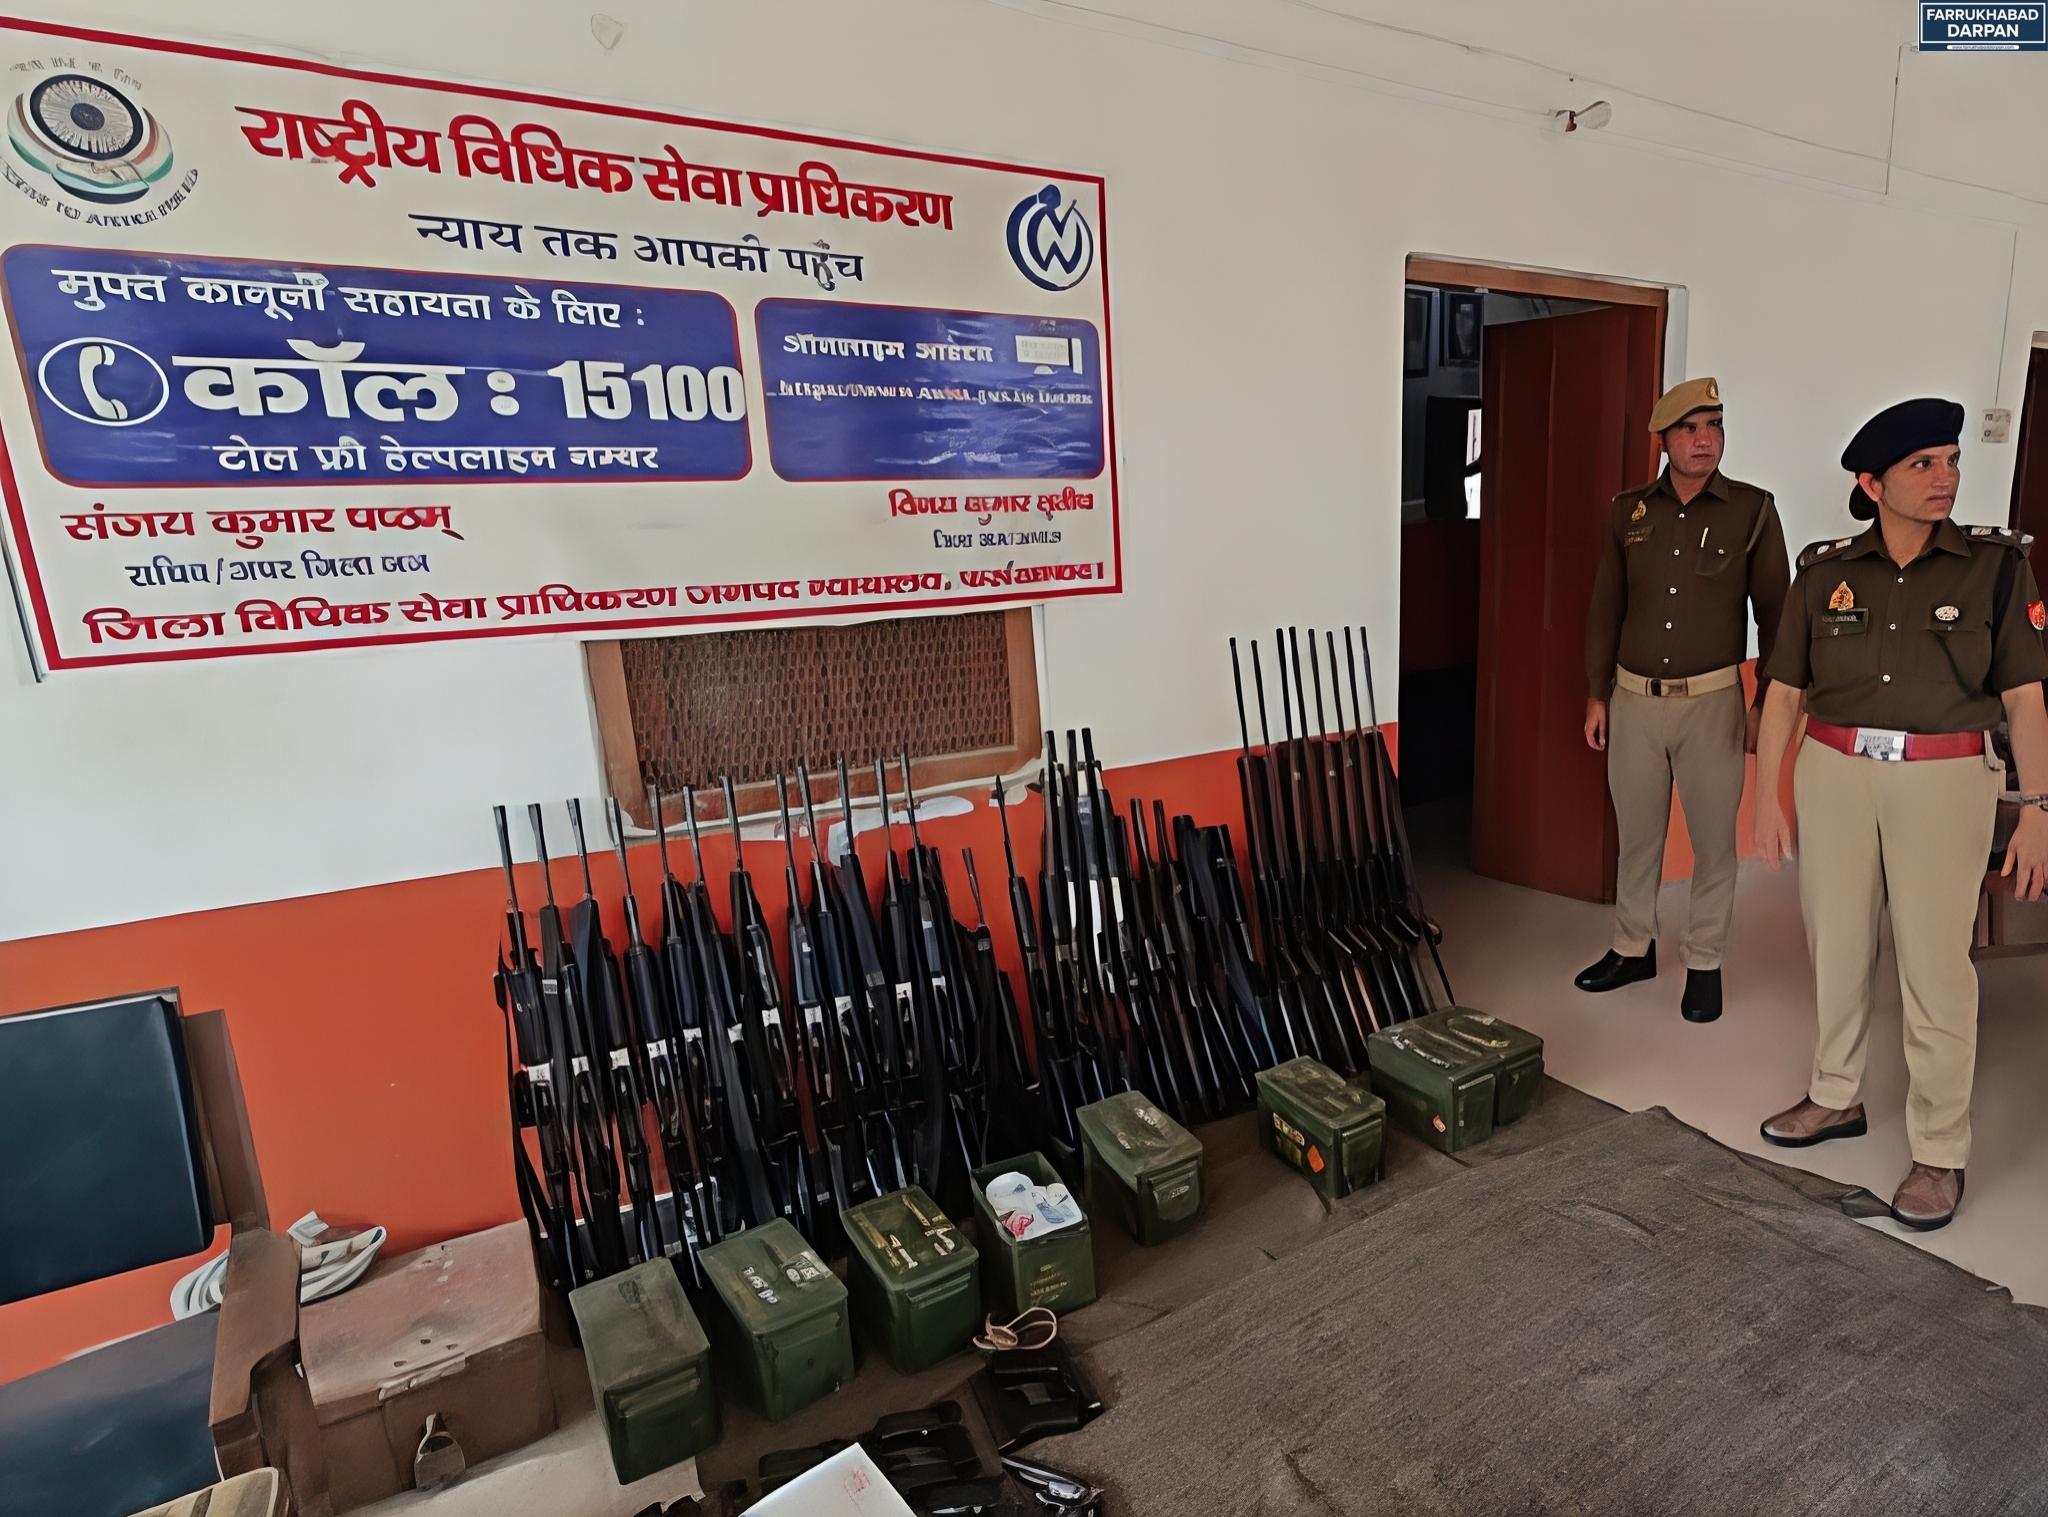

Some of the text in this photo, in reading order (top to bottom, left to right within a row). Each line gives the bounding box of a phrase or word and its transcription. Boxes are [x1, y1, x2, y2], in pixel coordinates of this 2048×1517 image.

[234, 99, 954, 230] राष्ट्रीय विधिक सेवा प्राधिकरण
[407, 213, 523, 253] न्याय
[534, 225, 618, 260] तक
[503, 284, 541, 319] के
[551, 288, 620, 328] लिए
[172, 339, 466, 422] कॉल
[548, 360, 747, 421] 15100
[60, 503, 195, 541] संजय
[207, 508, 336, 549] कुमार
[398, 592, 487, 623] सेवा
